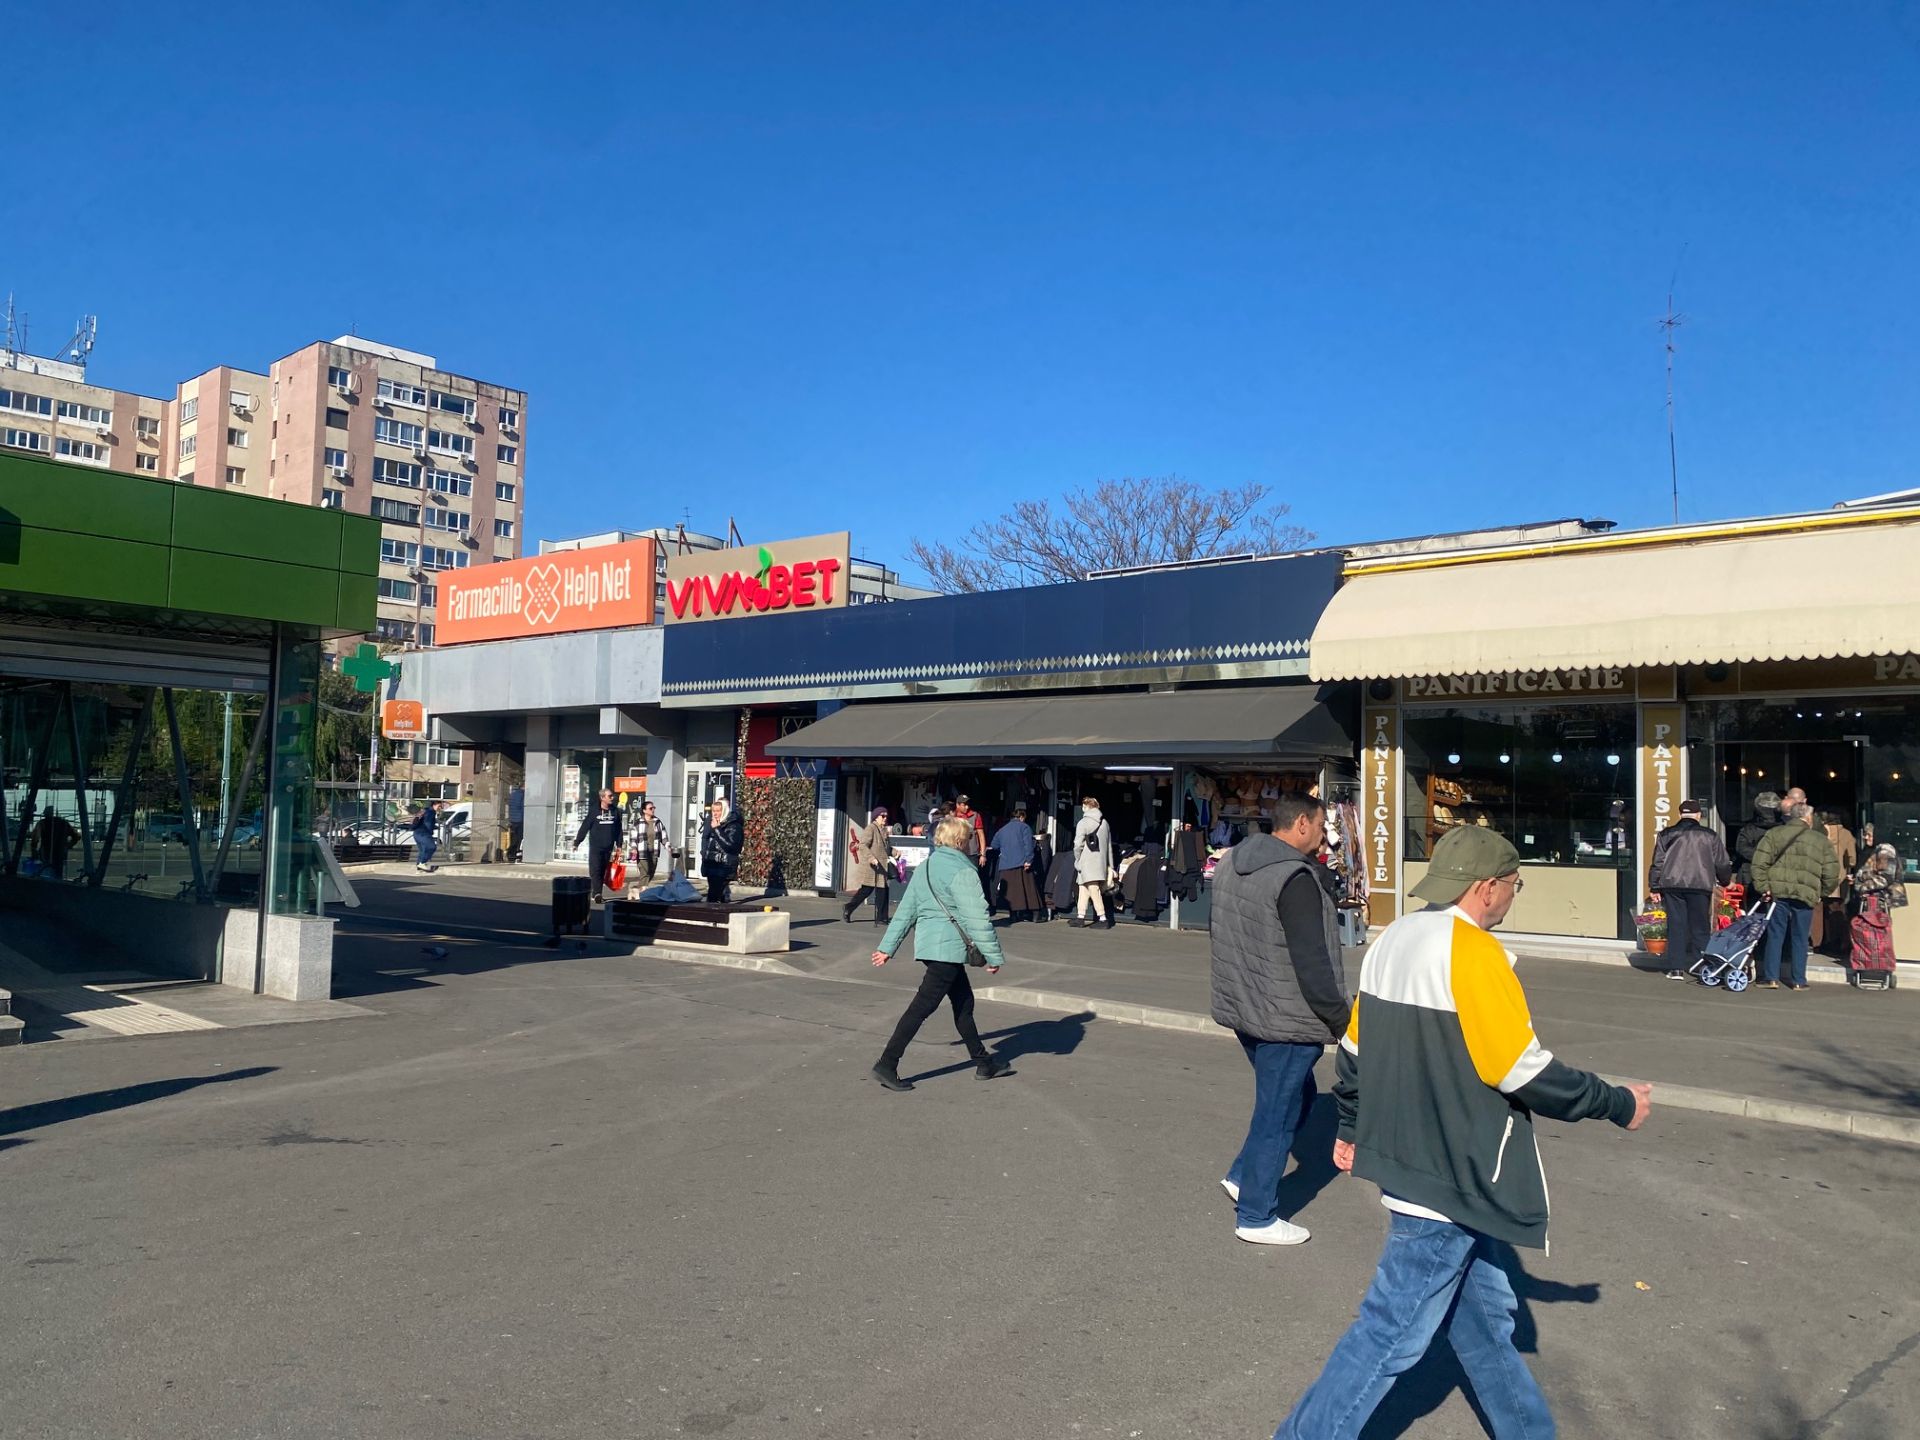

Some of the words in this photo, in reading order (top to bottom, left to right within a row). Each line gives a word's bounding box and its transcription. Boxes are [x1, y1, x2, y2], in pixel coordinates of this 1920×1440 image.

[448, 577, 522, 621] Farmaciile
[563, 565, 599, 612] Help
[602, 559, 631, 602] Net
[1404, 668, 1624, 696] PANIFICATIE
[1373, 715, 1390, 882] PANIFICATIE
